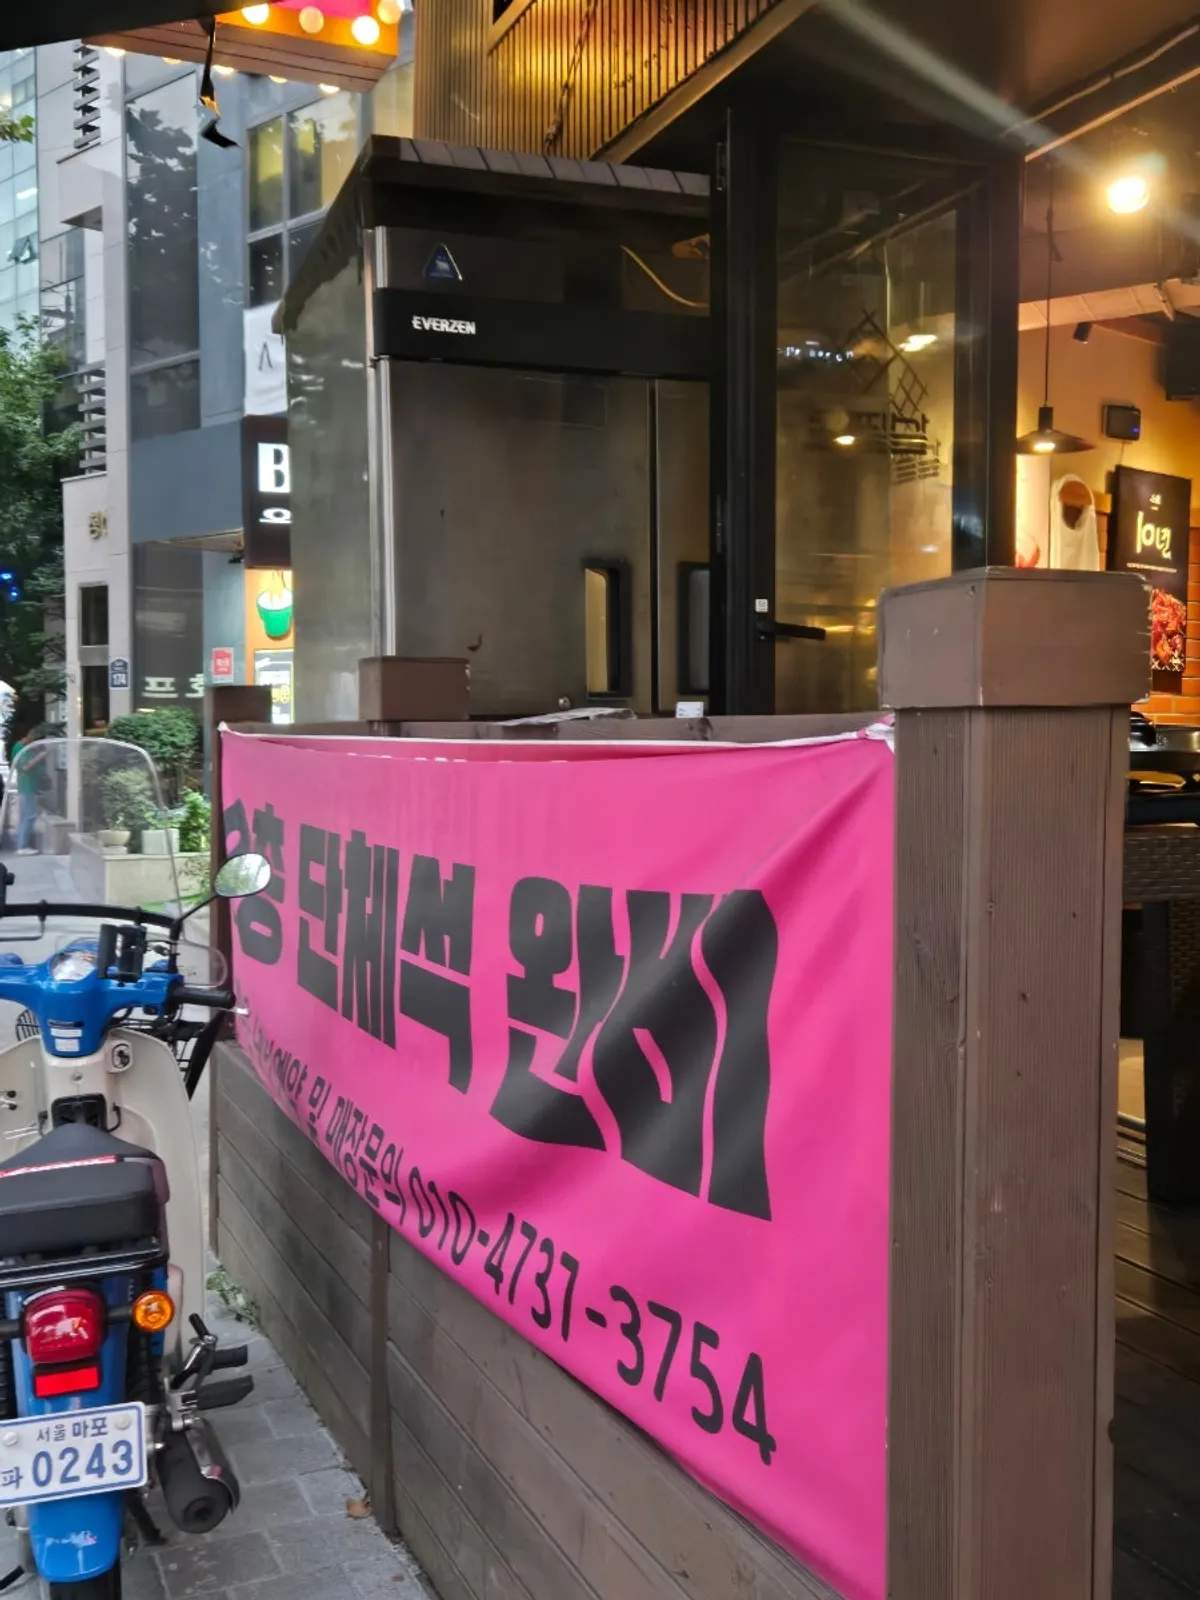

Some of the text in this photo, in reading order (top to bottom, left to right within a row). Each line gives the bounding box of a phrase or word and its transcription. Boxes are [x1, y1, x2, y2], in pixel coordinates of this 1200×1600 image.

[411, 315, 476, 335] EVERZEN
[297, 822, 476, 1096] 단체석
[488, 876, 778, 1222] 완비
[307, 1075, 332, 1141] 및
[408, 1166, 777, 1466] 010-4737-3754
[37, 1417, 109, 1442] 서울 마포
[32, 1440, 133, 1487] 0243
